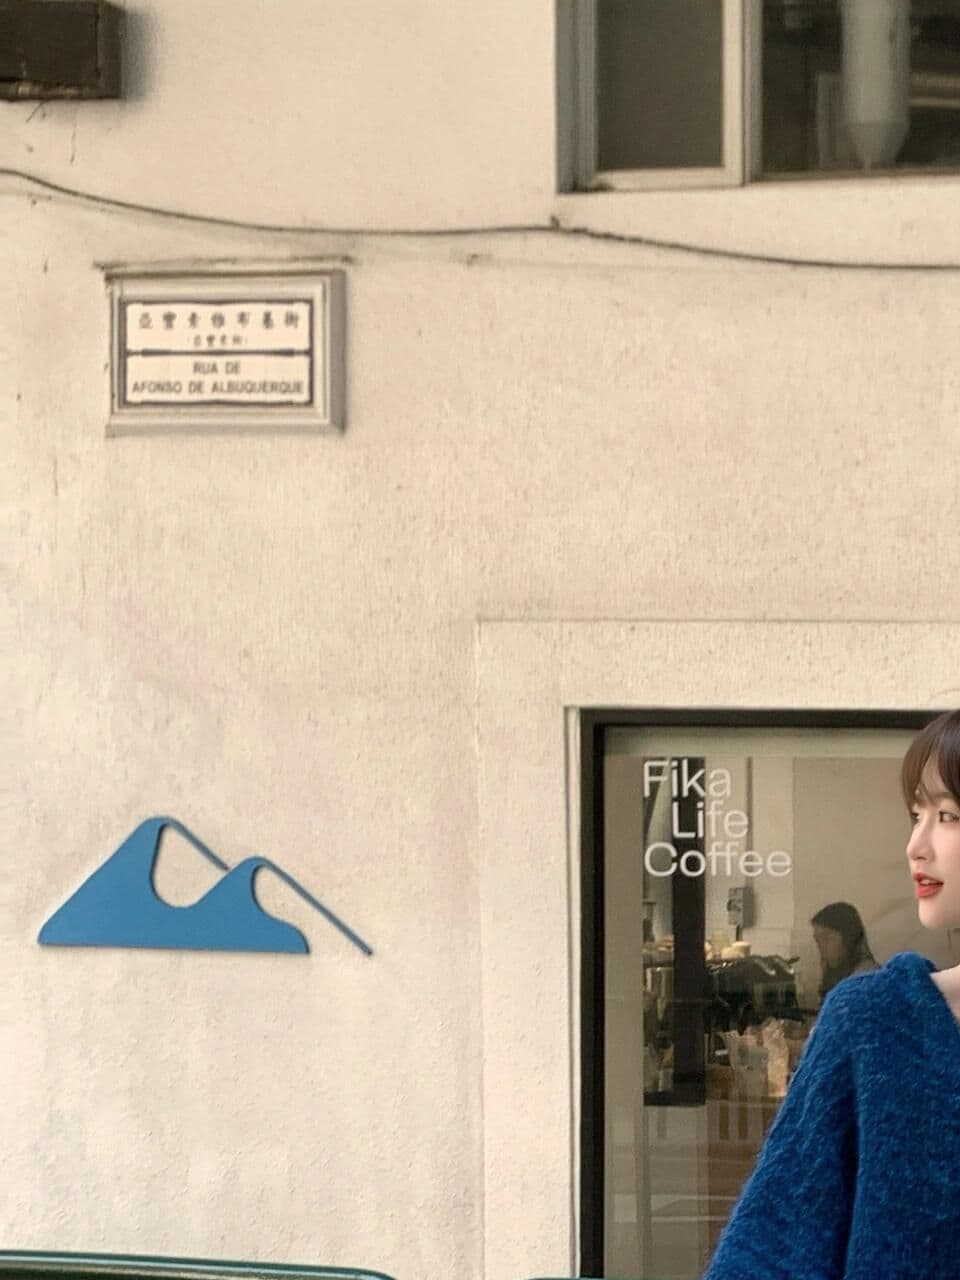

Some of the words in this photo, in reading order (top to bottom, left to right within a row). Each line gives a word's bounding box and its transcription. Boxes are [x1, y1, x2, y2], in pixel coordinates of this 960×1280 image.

[193, 361, 218, 374] RUA
[225, 361, 241, 374] DE
[132, 380, 182, 393] AFONSO
[188, 381, 203, 393] DE
[211, 380, 303, 394] ALBUQUERQUE
[643, 758, 731, 798] Fika
[672, 800, 749, 838] Life
[644, 841, 793, 877] Coffee
